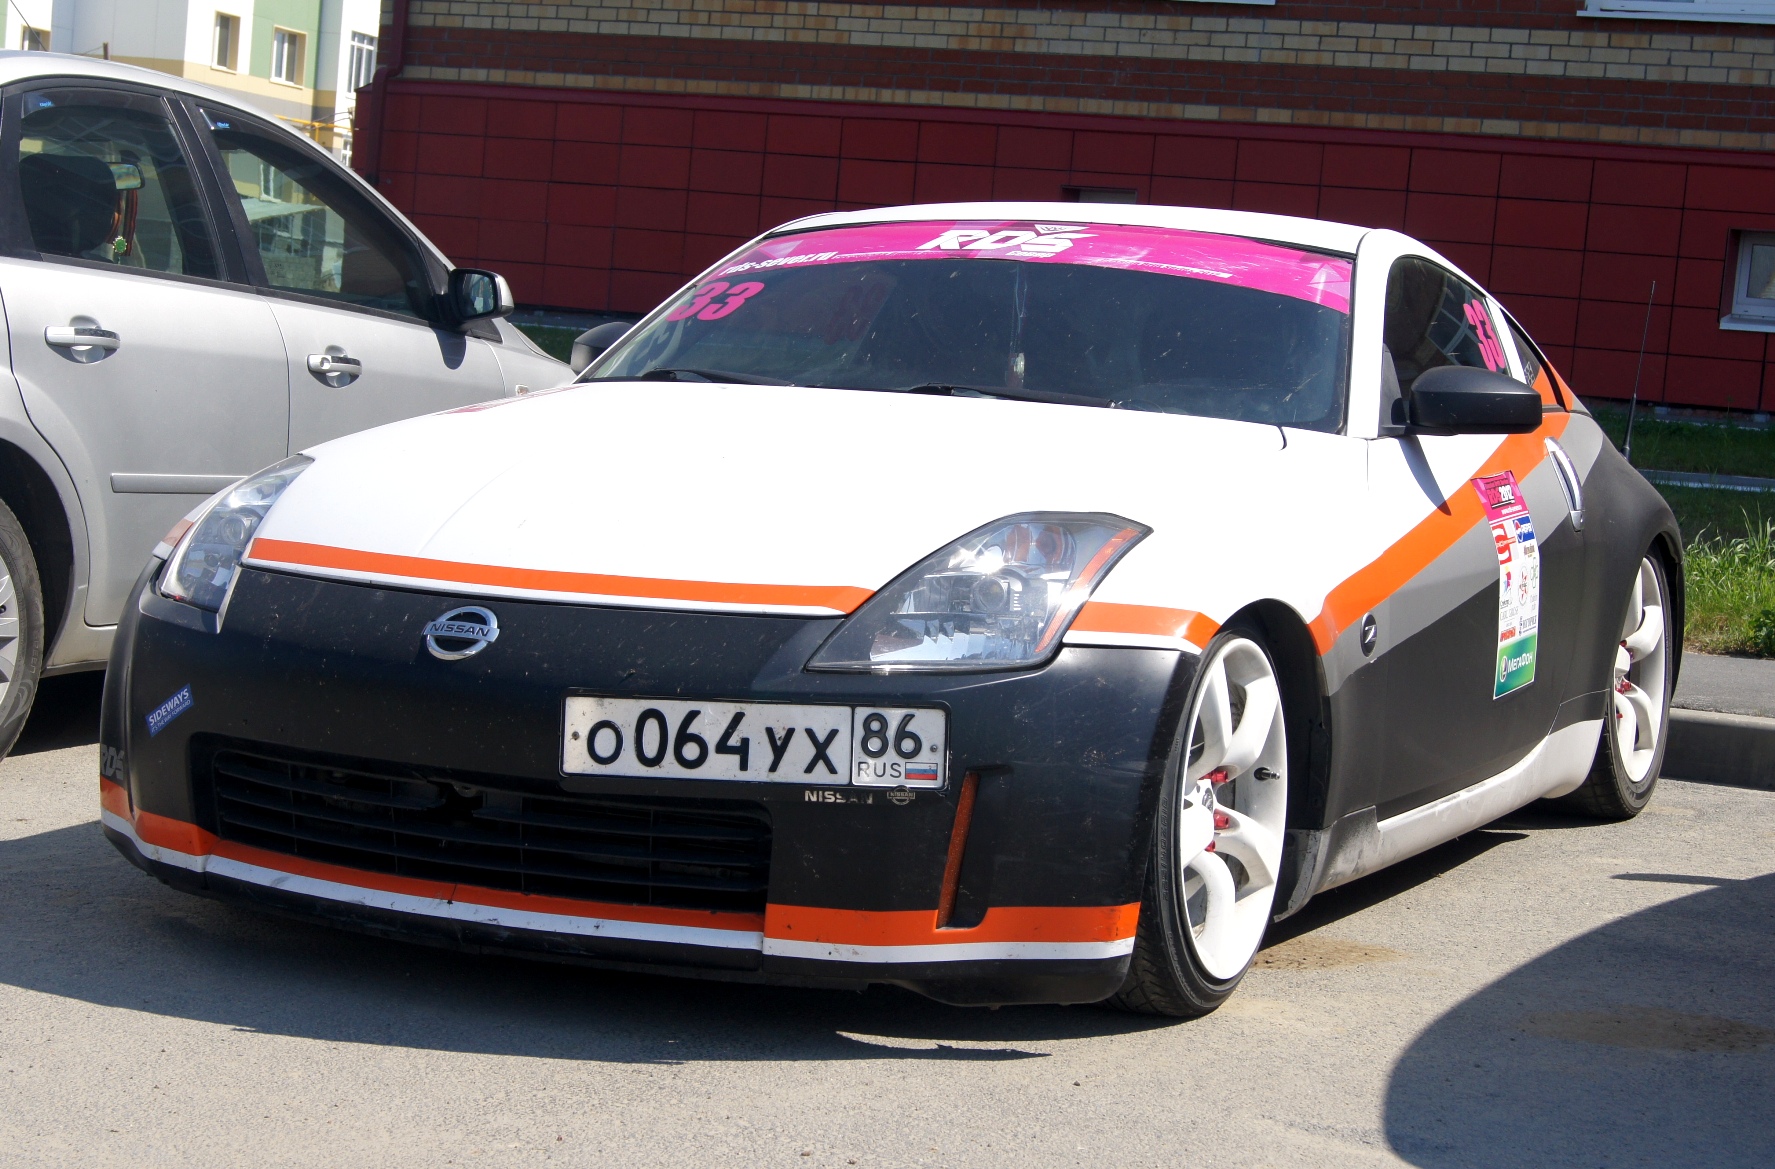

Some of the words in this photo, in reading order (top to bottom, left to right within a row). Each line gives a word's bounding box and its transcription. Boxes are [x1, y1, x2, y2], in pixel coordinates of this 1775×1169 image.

[915, 229, 1099, 252] RDS
[665, 281, 765, 322] 33
[1463, 299, 1505, 372] 33
[429, 623, 490, 637] NISSAN
[148, 688, 189, 726] SIDEWAYS
[861, 712, 923, 759] 86
[100, 743, 125, 780] RDS
[857, 761, 902, 778] RUS
